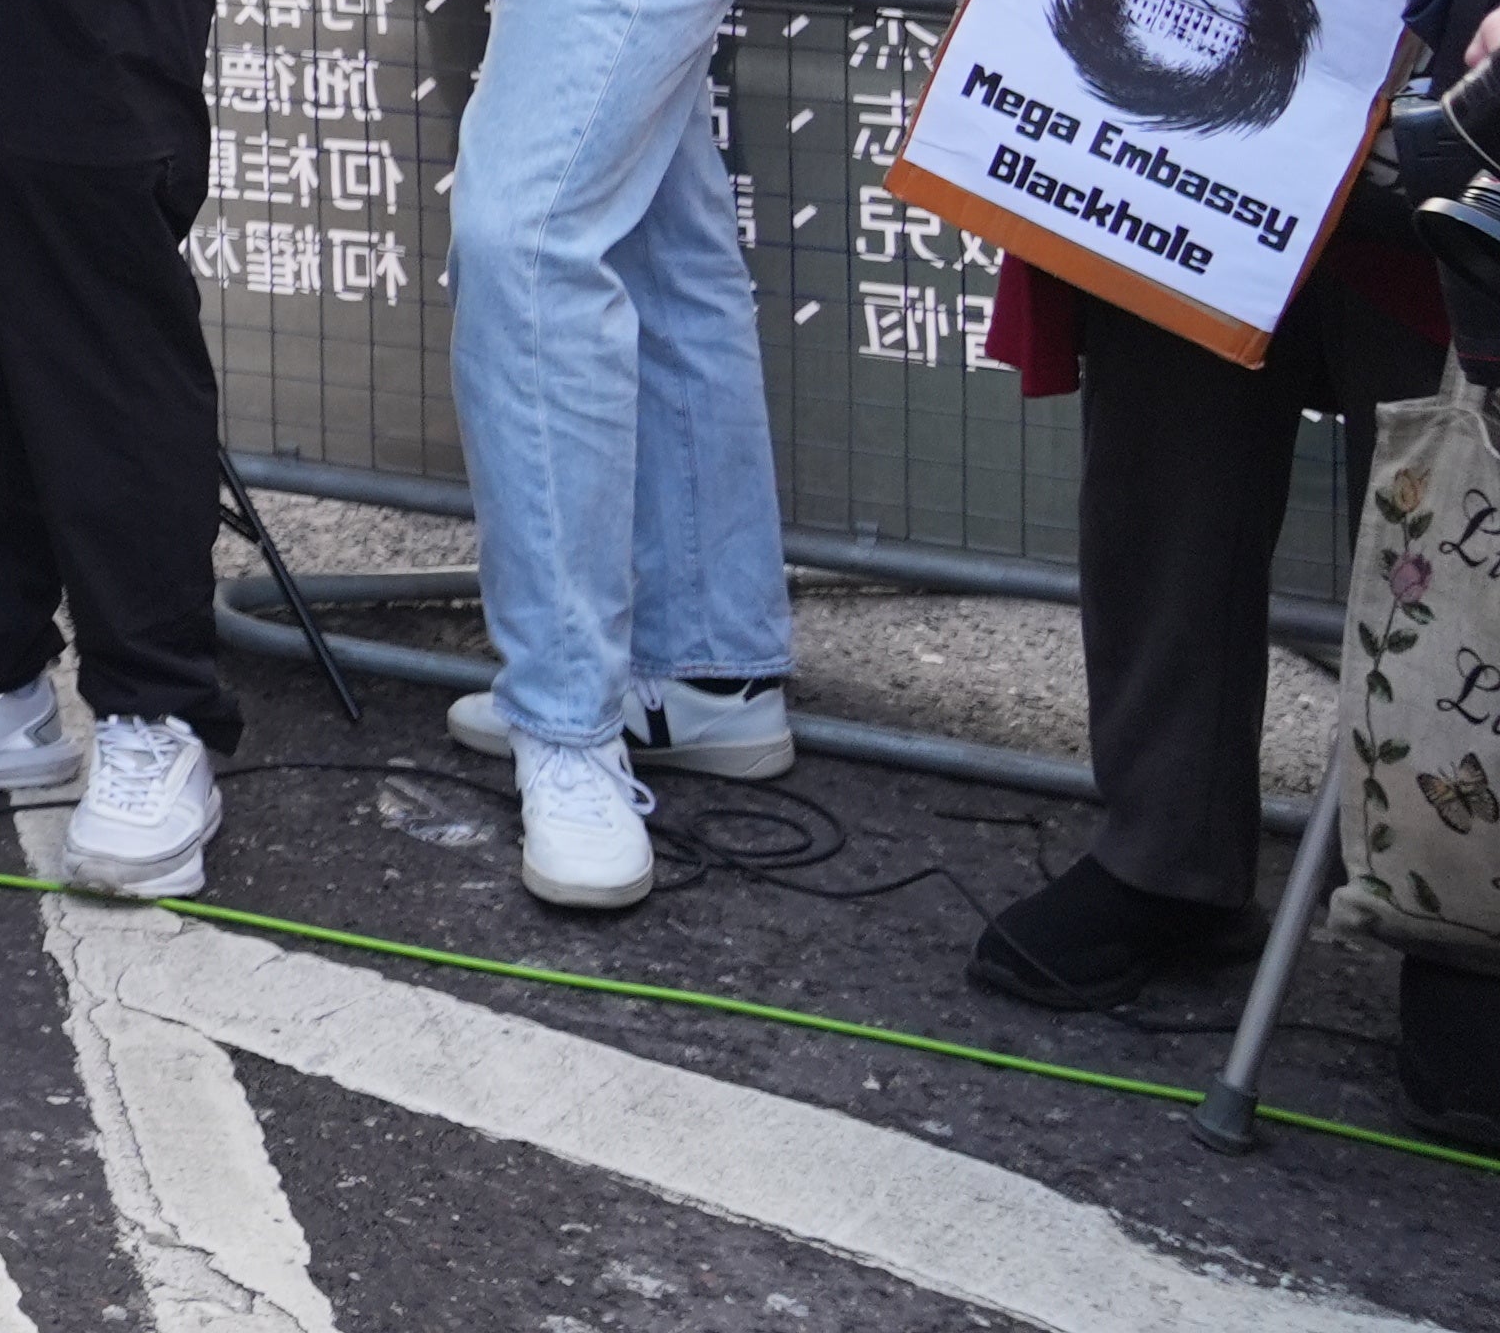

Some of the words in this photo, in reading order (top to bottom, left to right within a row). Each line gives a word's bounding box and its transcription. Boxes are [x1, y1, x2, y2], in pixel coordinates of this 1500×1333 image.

[960, 63, 1081, 144] Mega
[1088, 120, 1300, 254] Embassy
[986, 143, 1214, 275] Blackhole
